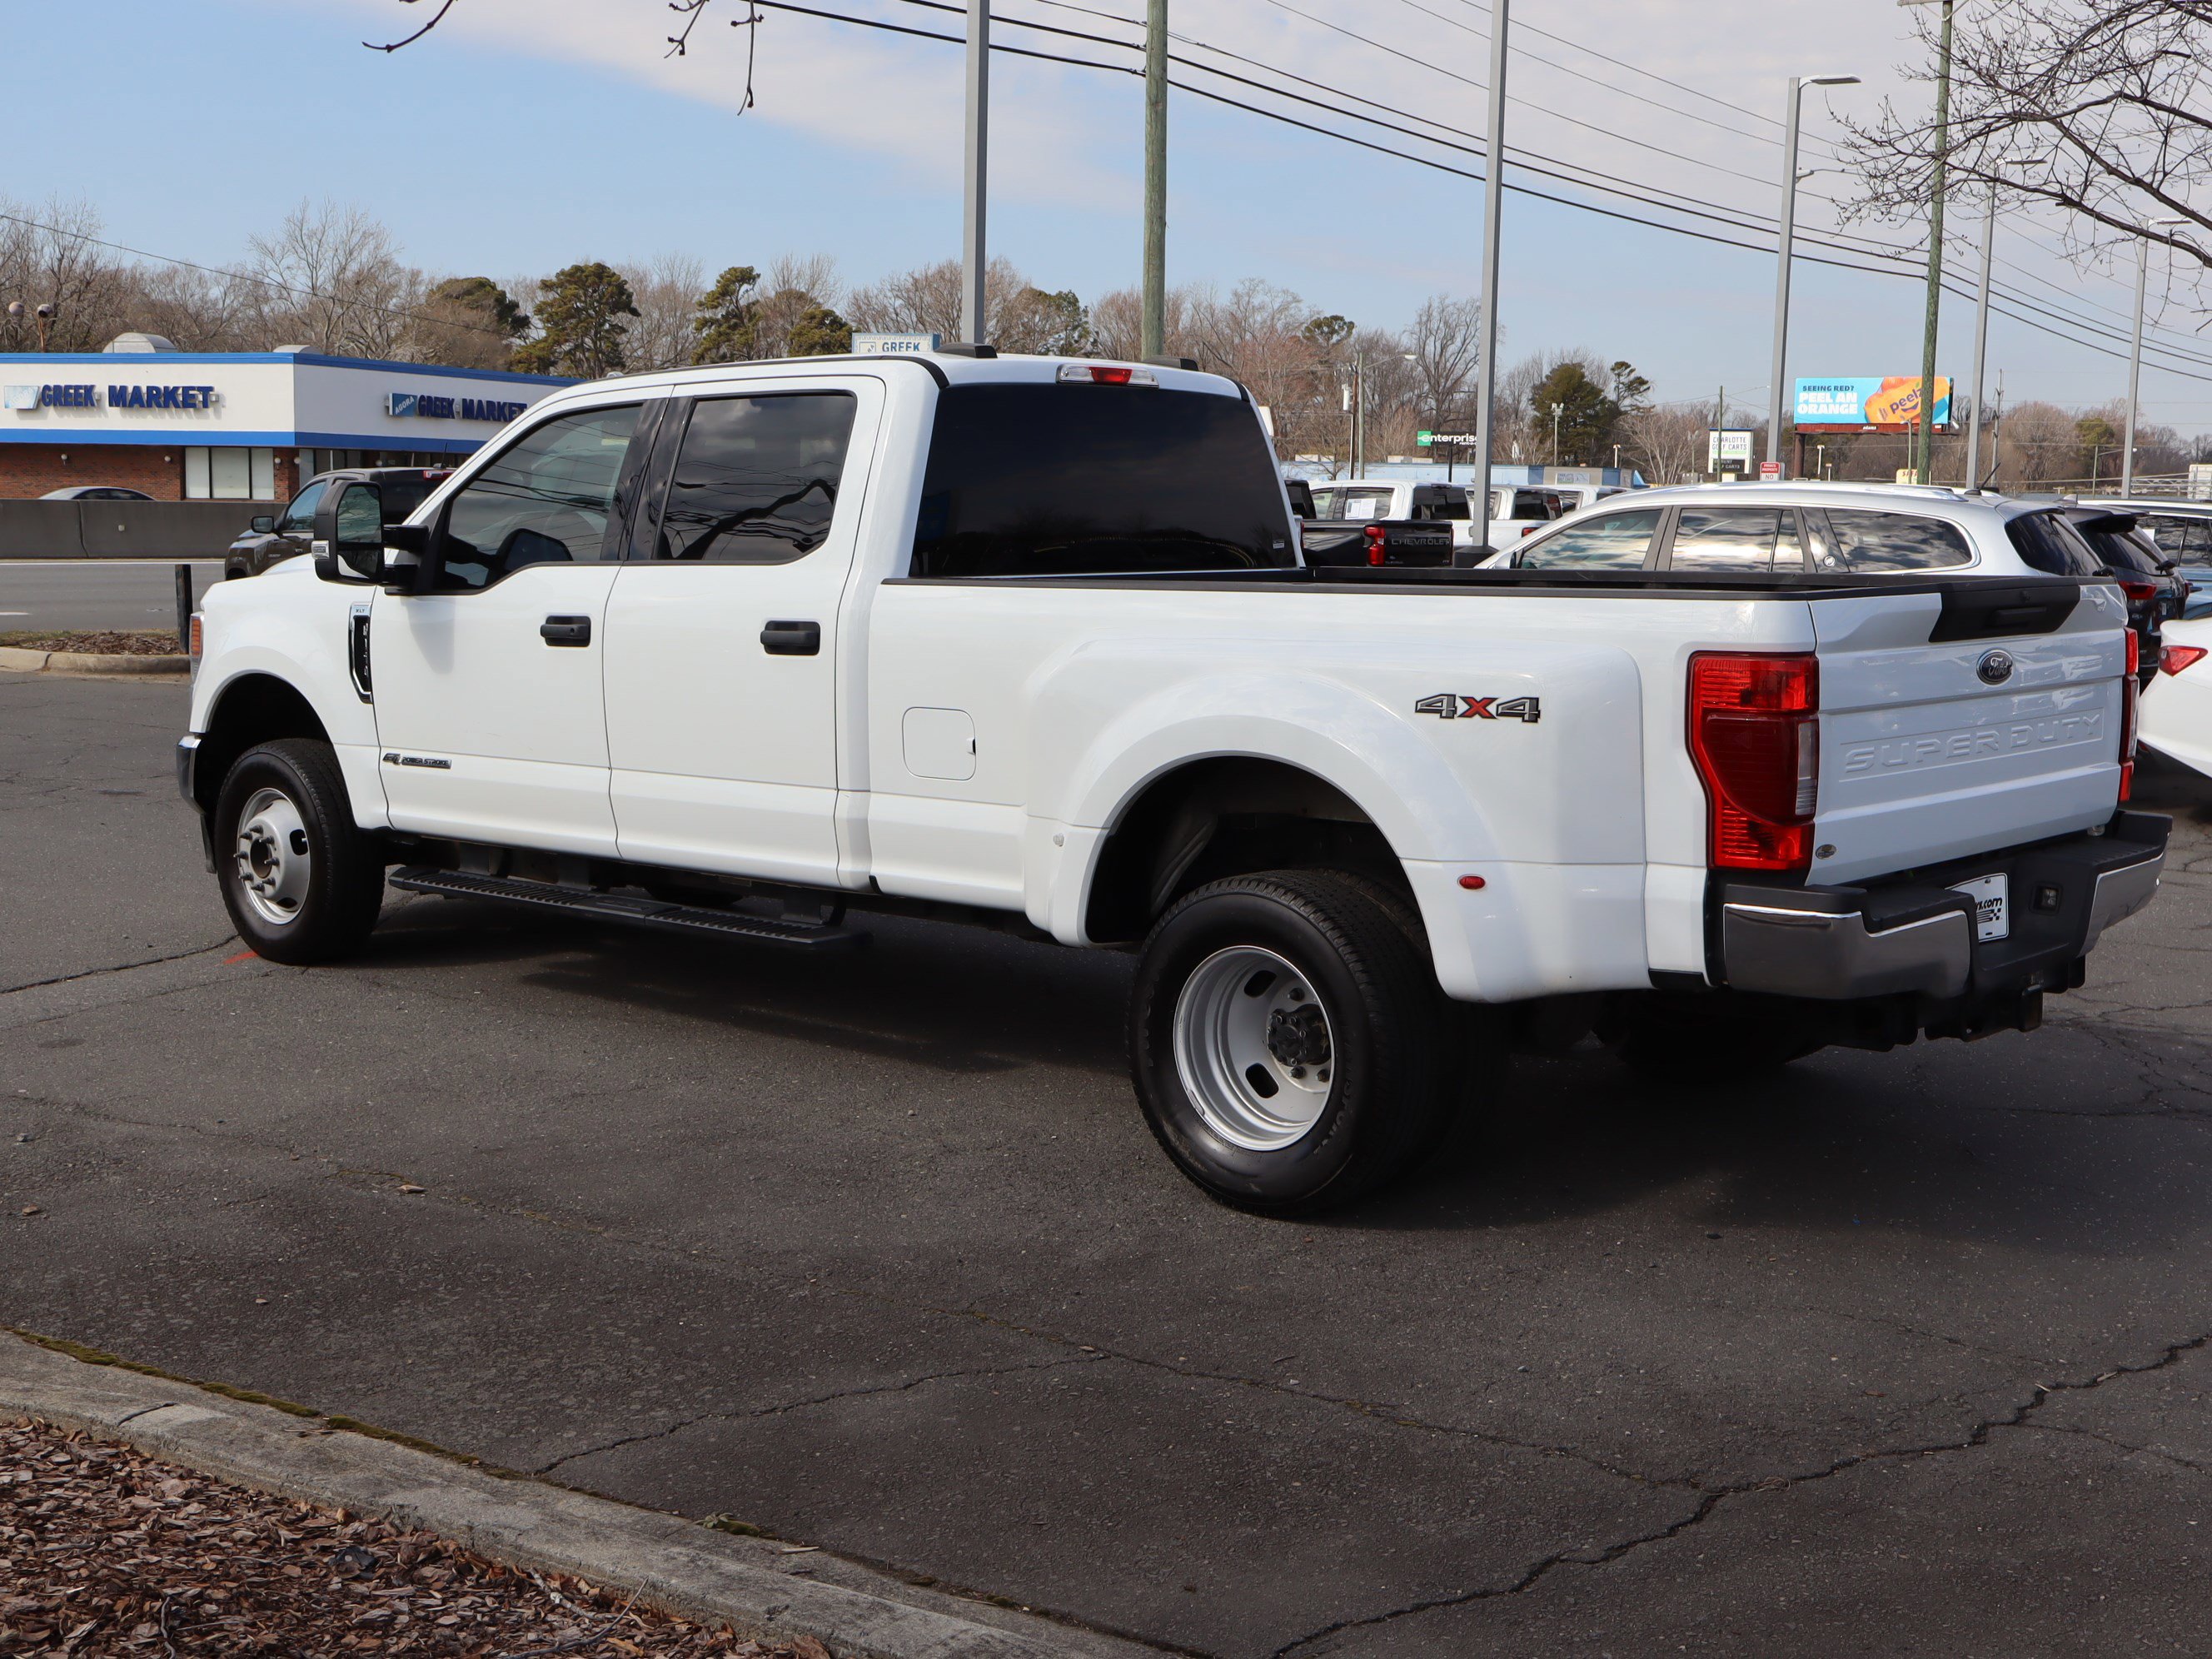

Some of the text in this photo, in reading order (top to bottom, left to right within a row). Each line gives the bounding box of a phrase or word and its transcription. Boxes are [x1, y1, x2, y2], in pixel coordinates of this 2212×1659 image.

[882, 342, 920, 352] GREEK
[42, 384, 97, 407] GREEK
[108, 386, 215, 408] MARKET
[395, 396, 415, 415] AGORA
[1799, 392, 1858, 403] PEEL AN
[418, 395, 527, 422] GREEK MARKET
[1797, 403, 1858, 415] ORANGE
[1989, 656, 2013, 676] Ford
[1845, 713, 2102, 773] SUPER DUTY
